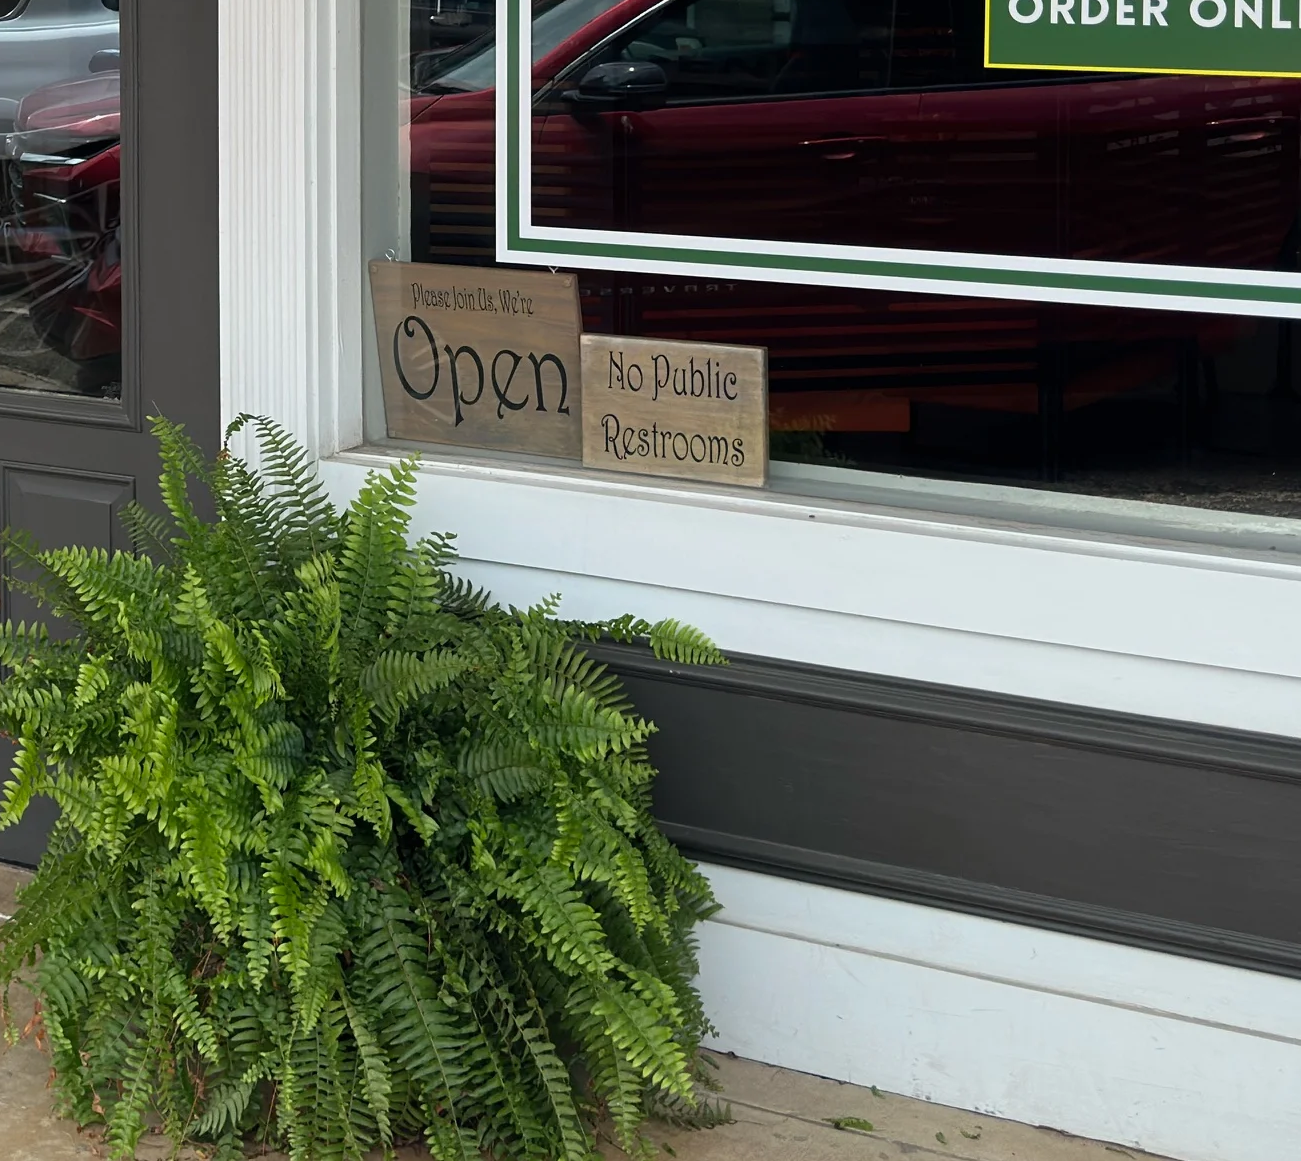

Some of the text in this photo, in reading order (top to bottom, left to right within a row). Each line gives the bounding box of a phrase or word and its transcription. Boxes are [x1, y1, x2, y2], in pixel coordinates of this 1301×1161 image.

[411, 282, 535, 317] Please Join Us, We're
[393, 315, 571, 428] Open
[607, 350, 739, 402] No Public
[600, 413, 746, 468] Restrooms
